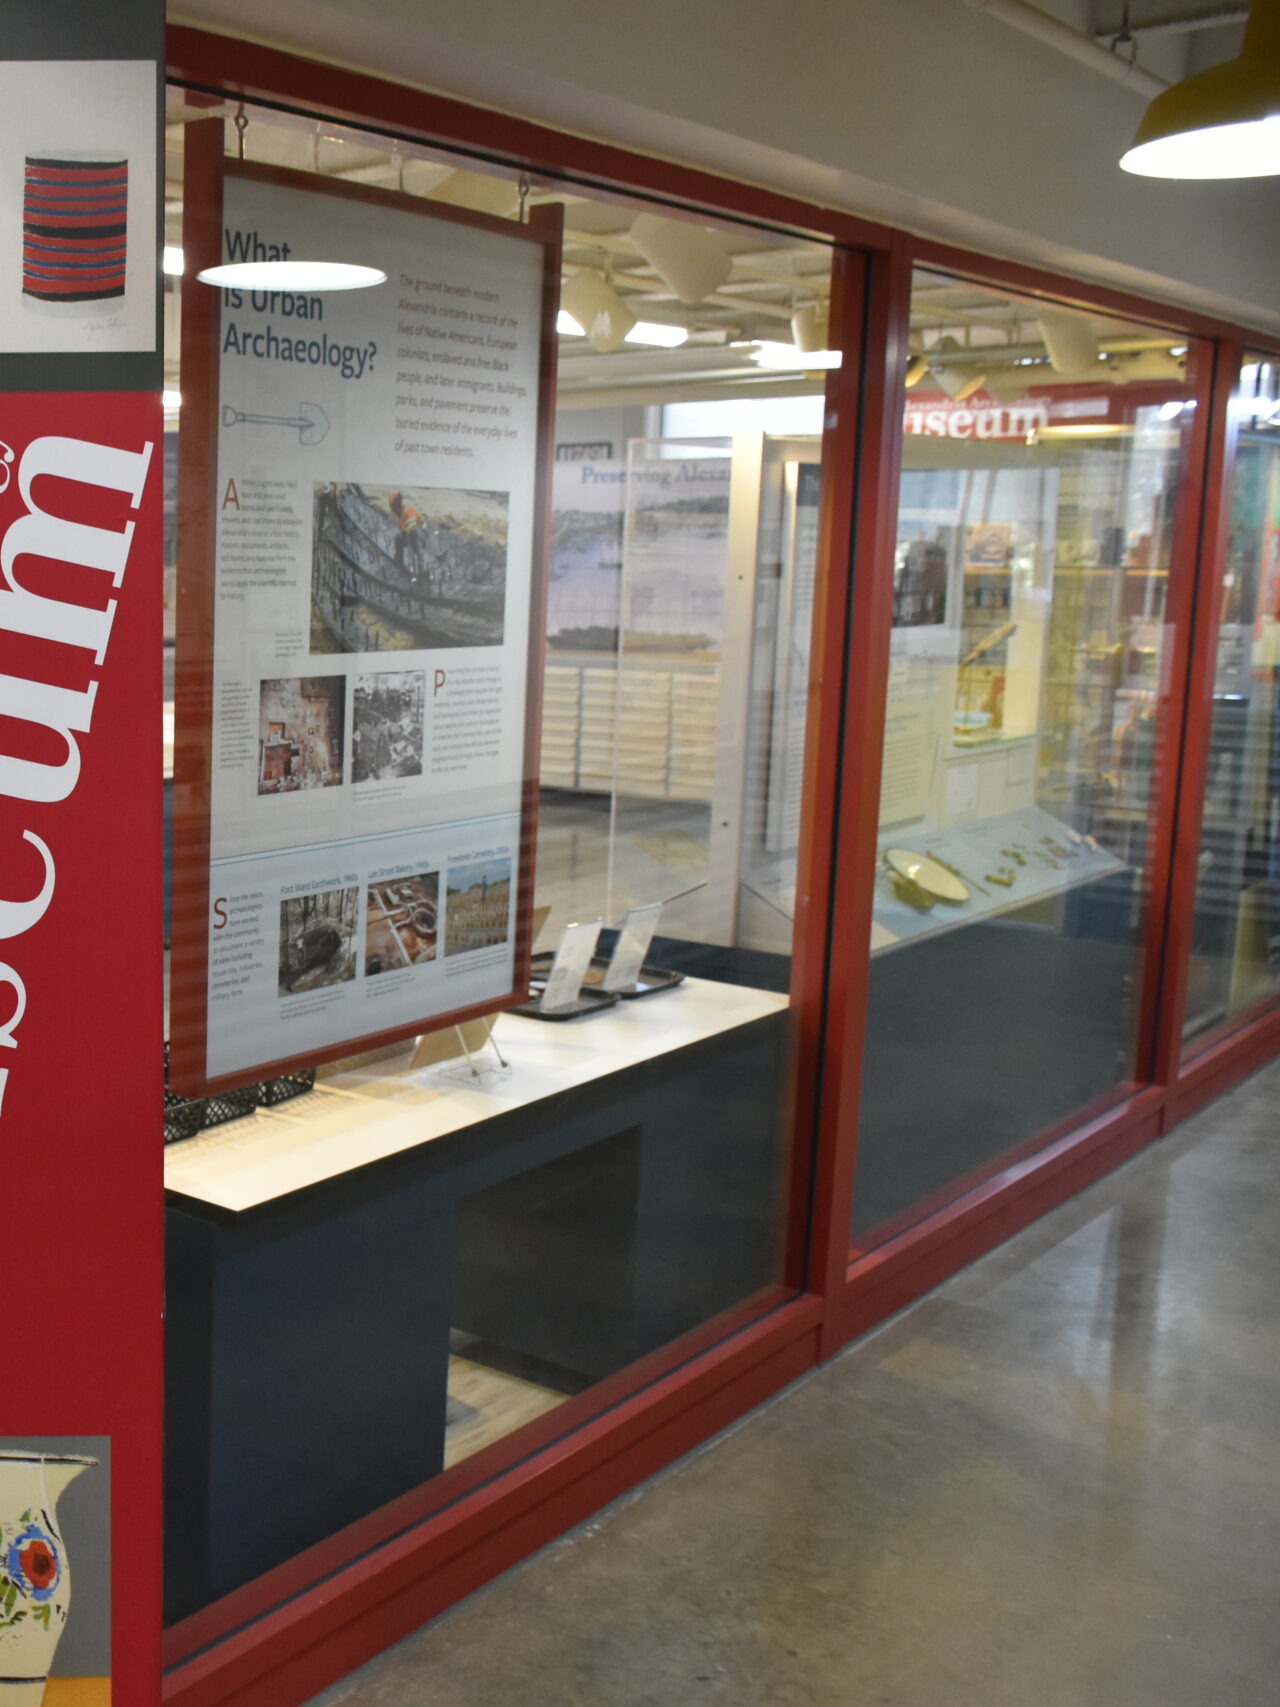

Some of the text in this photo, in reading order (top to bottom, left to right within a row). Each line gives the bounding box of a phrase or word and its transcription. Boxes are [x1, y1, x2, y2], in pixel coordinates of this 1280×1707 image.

[225, 228, 291, 262] What
[400, 273, 414, 288] The
[415, 279, 441, 293] ground
[251, 289, 323, 320] Urban
[398, 298, 437, 315] Alexandria
[398, 321, 414, 335] lives
[415, 324, 423, 336] of
[425, 327, 447, 340] Native
[486, 335, 518, 352] European
[223, 322, 377, 379] Archaeology?
[491, 358, 509, 371] Black
[424, 374, 438, 385] and
[419, 397, 433, 409] and
[452, 421, 461, 433] of
[461, 423, 472, 435] the
[394, 440, 403, 452] of
[404, 443, 420, 455] past
[421, 444, 440, 454] town
[280, 885, 293, 895] Fort
[295, 879, 310, 892] Ward
